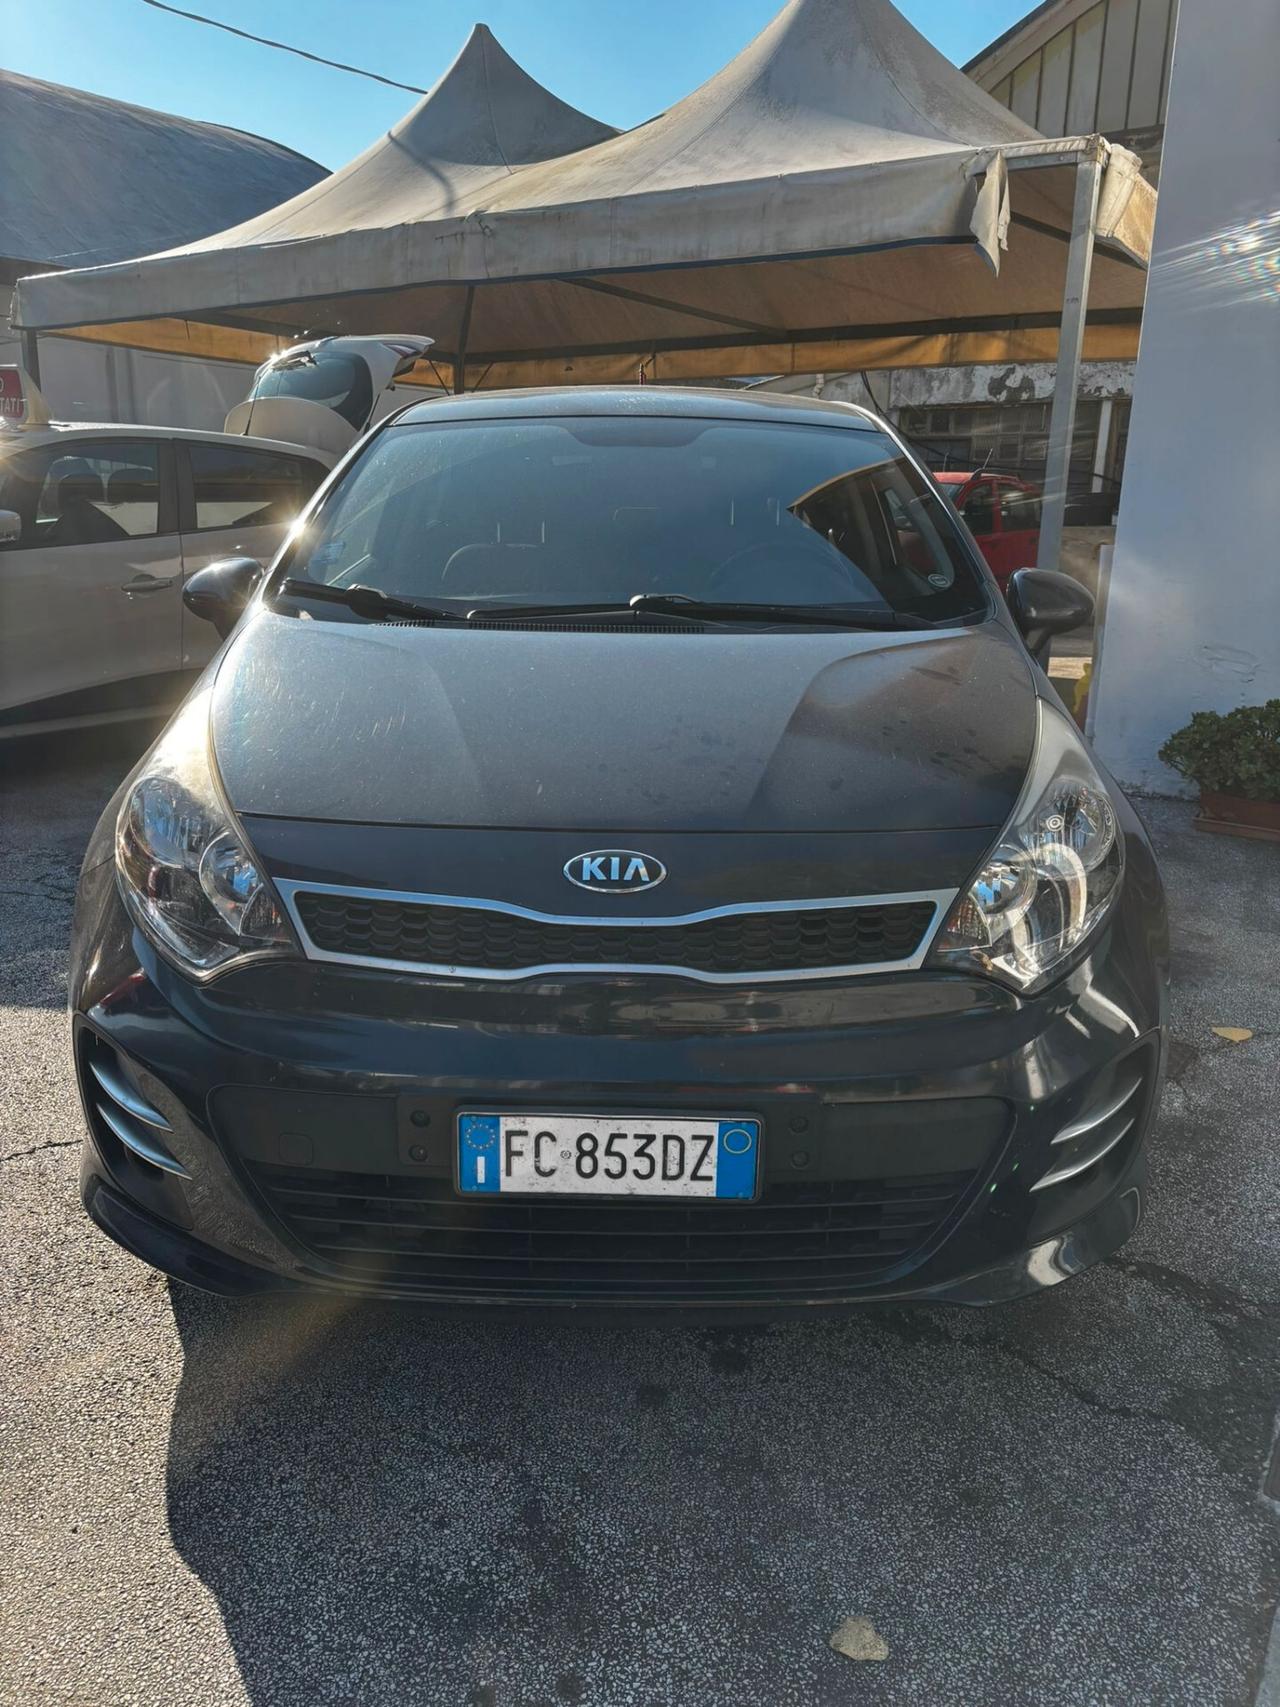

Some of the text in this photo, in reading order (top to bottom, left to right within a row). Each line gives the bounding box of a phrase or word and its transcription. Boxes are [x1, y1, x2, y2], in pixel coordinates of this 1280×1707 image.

[582, 857, 650, 881] KIA
[505, 1130, 715, 1182] FC 853DZ
